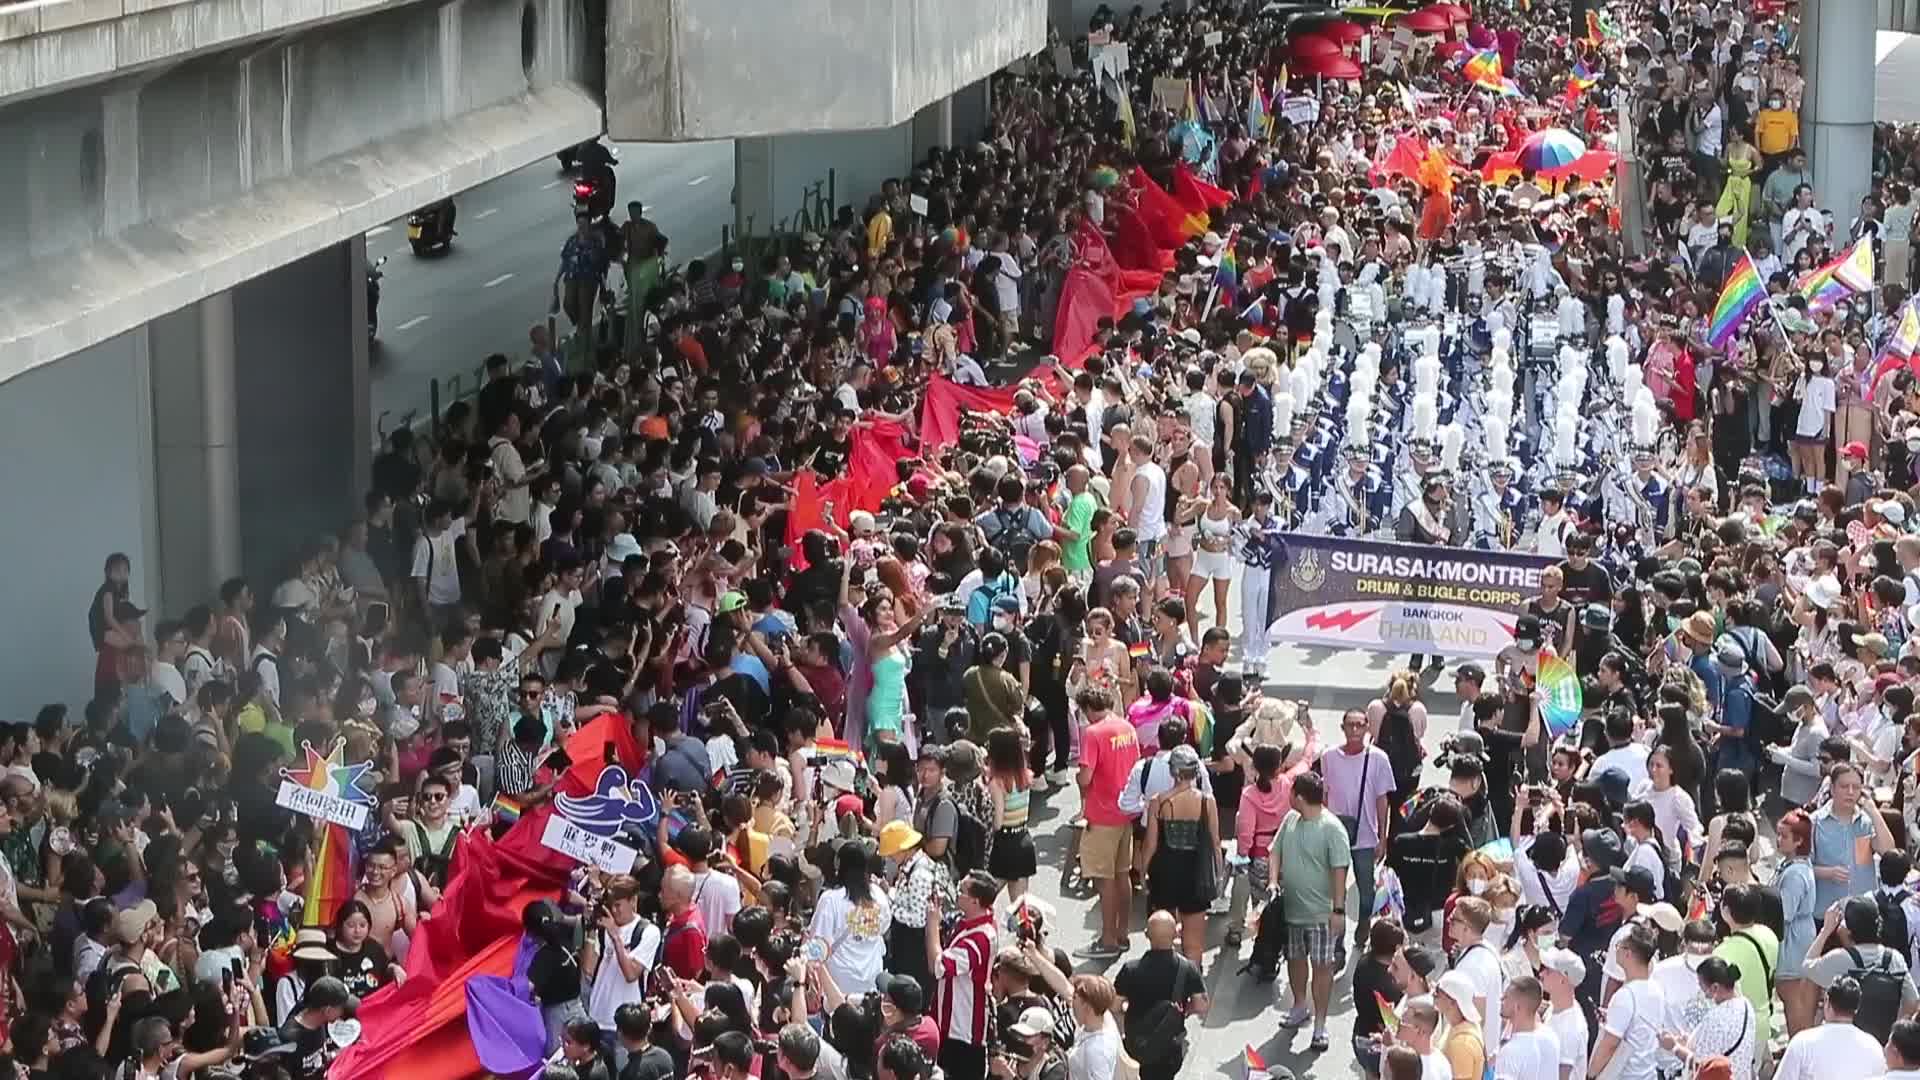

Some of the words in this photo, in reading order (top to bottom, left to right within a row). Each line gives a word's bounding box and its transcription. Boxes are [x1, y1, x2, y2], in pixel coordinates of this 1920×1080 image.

[1331, 551, 1542, 588] SURASAKMONTRE
[1356, 579, 1400, 595] DRUM
[1402, 583, 1414, 597] &
[1417, 585, 1467, 601] BUGLE
[1469, 589, 1521, 606] CORPS
[1402, 607, 1463, 622] BANGKOK
[1378, 619, 1488, 646] THAILAND
